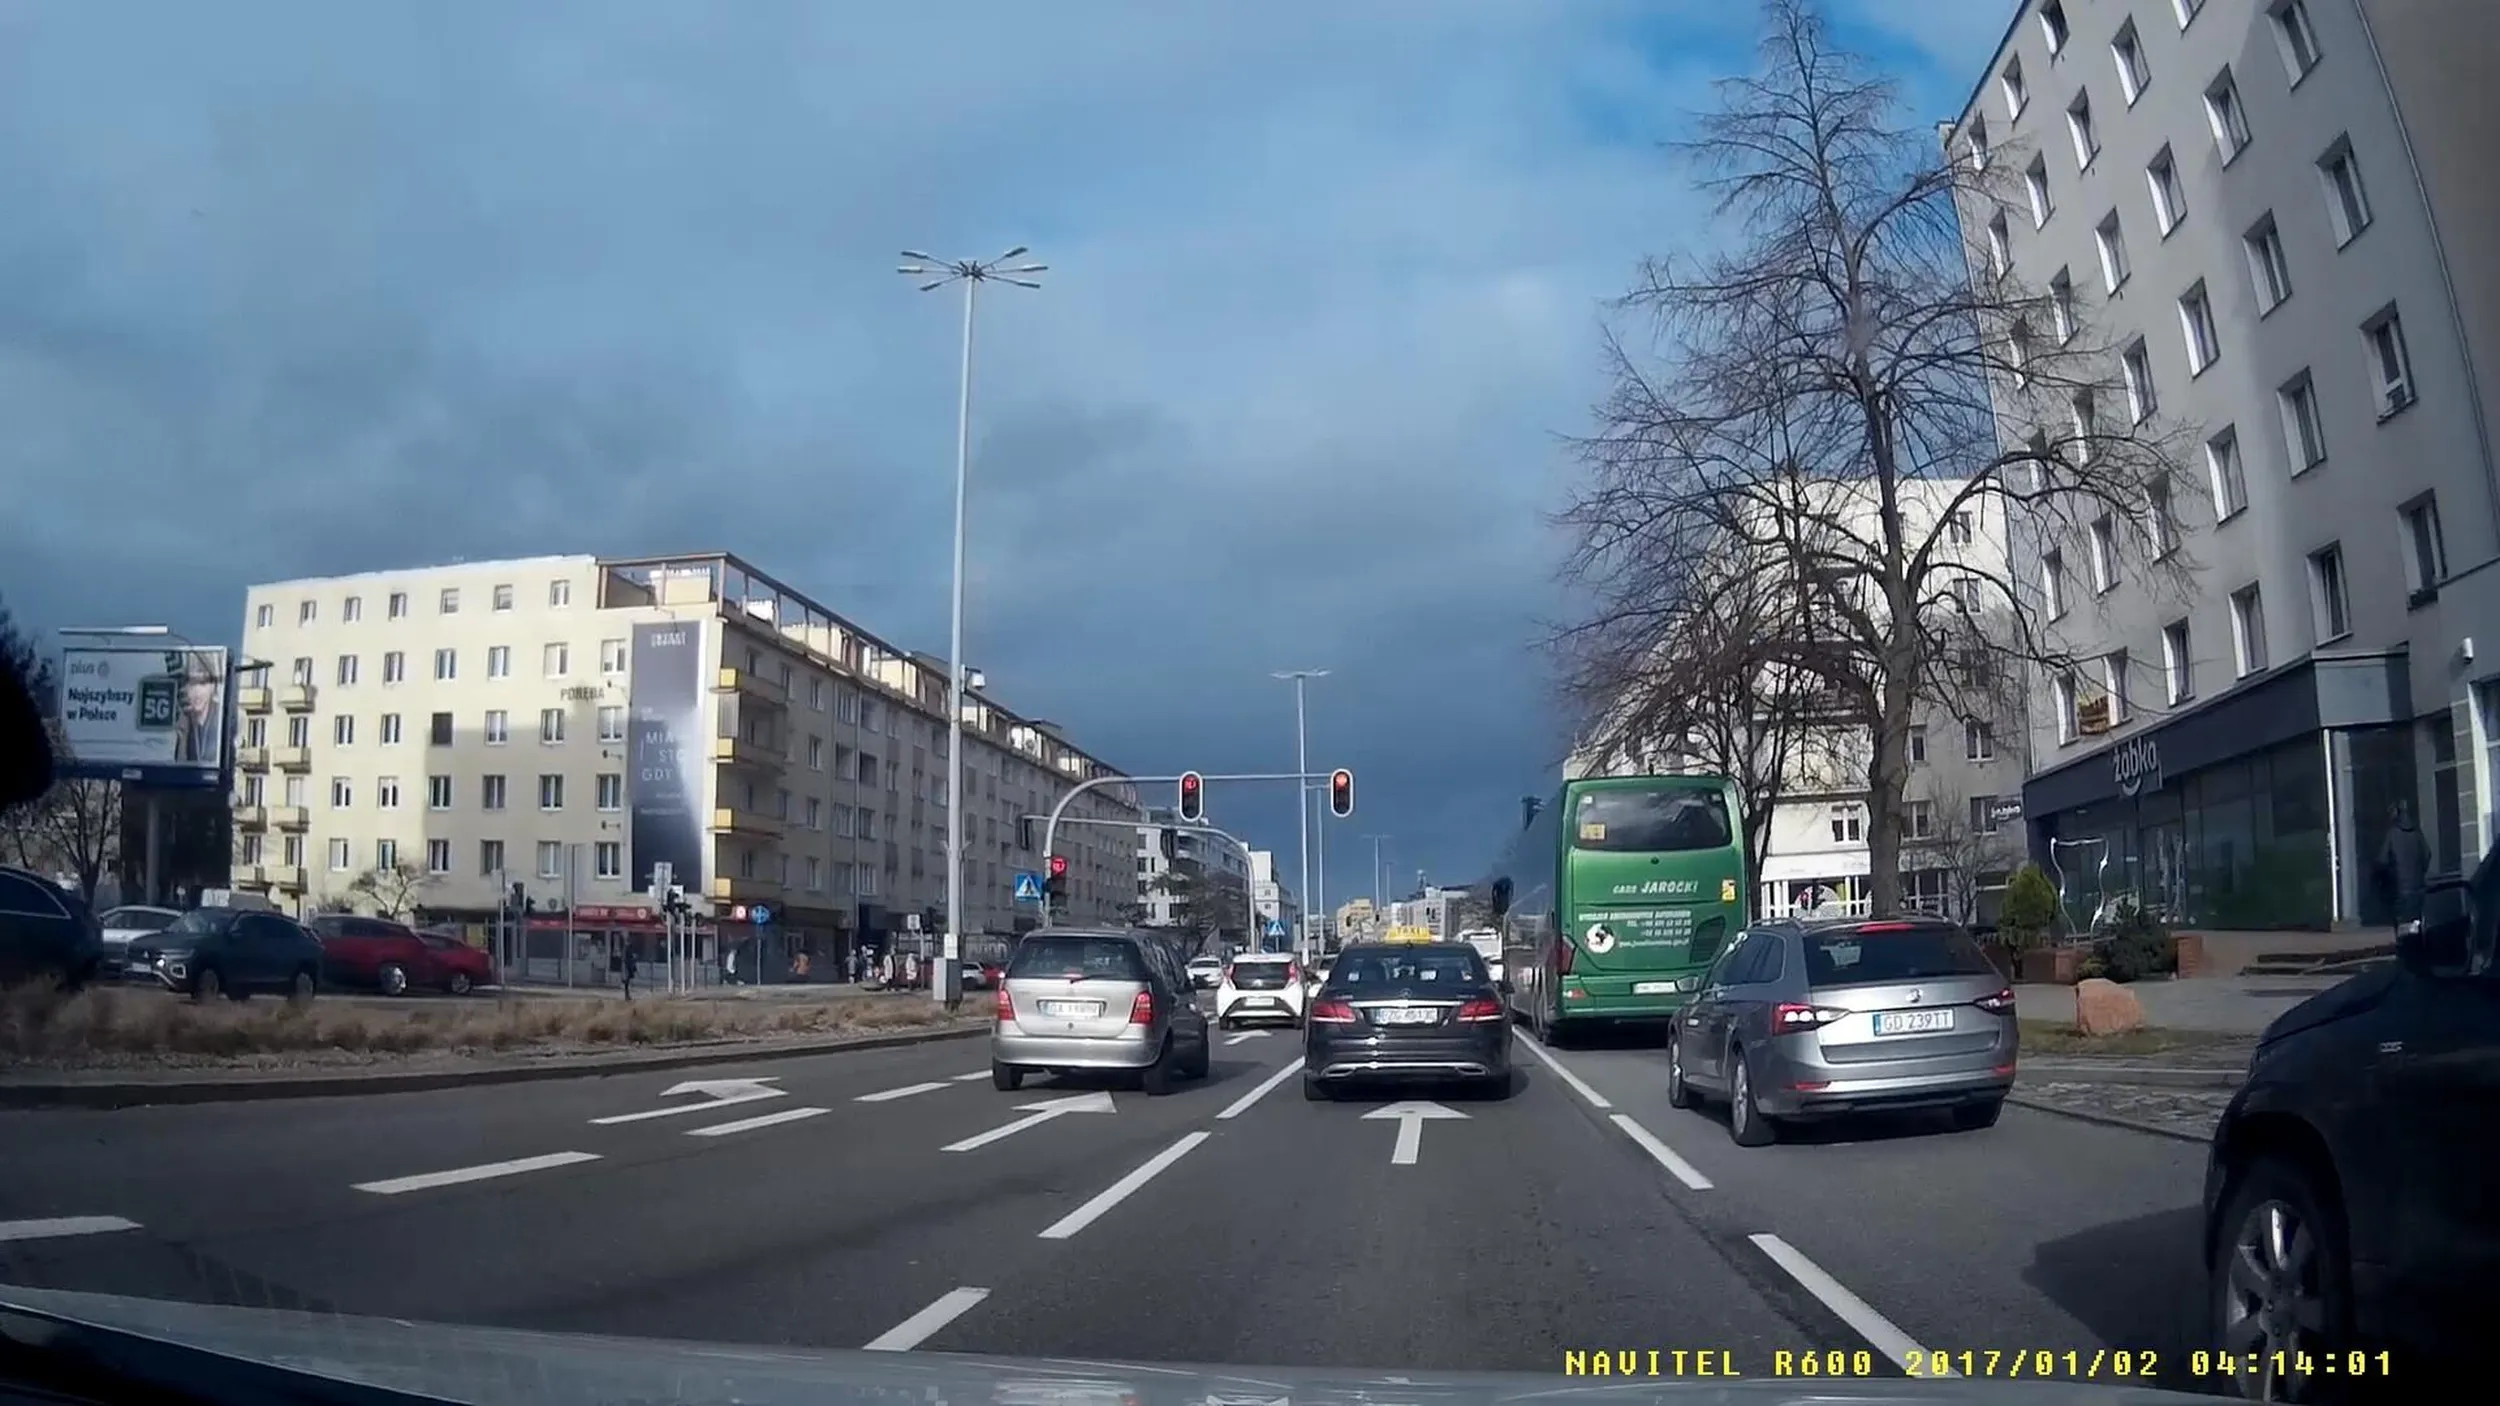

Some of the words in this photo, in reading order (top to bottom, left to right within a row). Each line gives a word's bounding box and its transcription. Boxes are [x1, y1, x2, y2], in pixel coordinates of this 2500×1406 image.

[68, 687, 135, 705] Najszybszy
[79, 706, 117, 721] Polsce
[144, 698, 170, 720] 5G
[2113, 737, 2159, 783] żabka
[1641, 880, 1698, 894] JAROCKI
[1884, 1015, 1903, 1031] GD
[1908, 1012, 1950, 1029] 239TT
